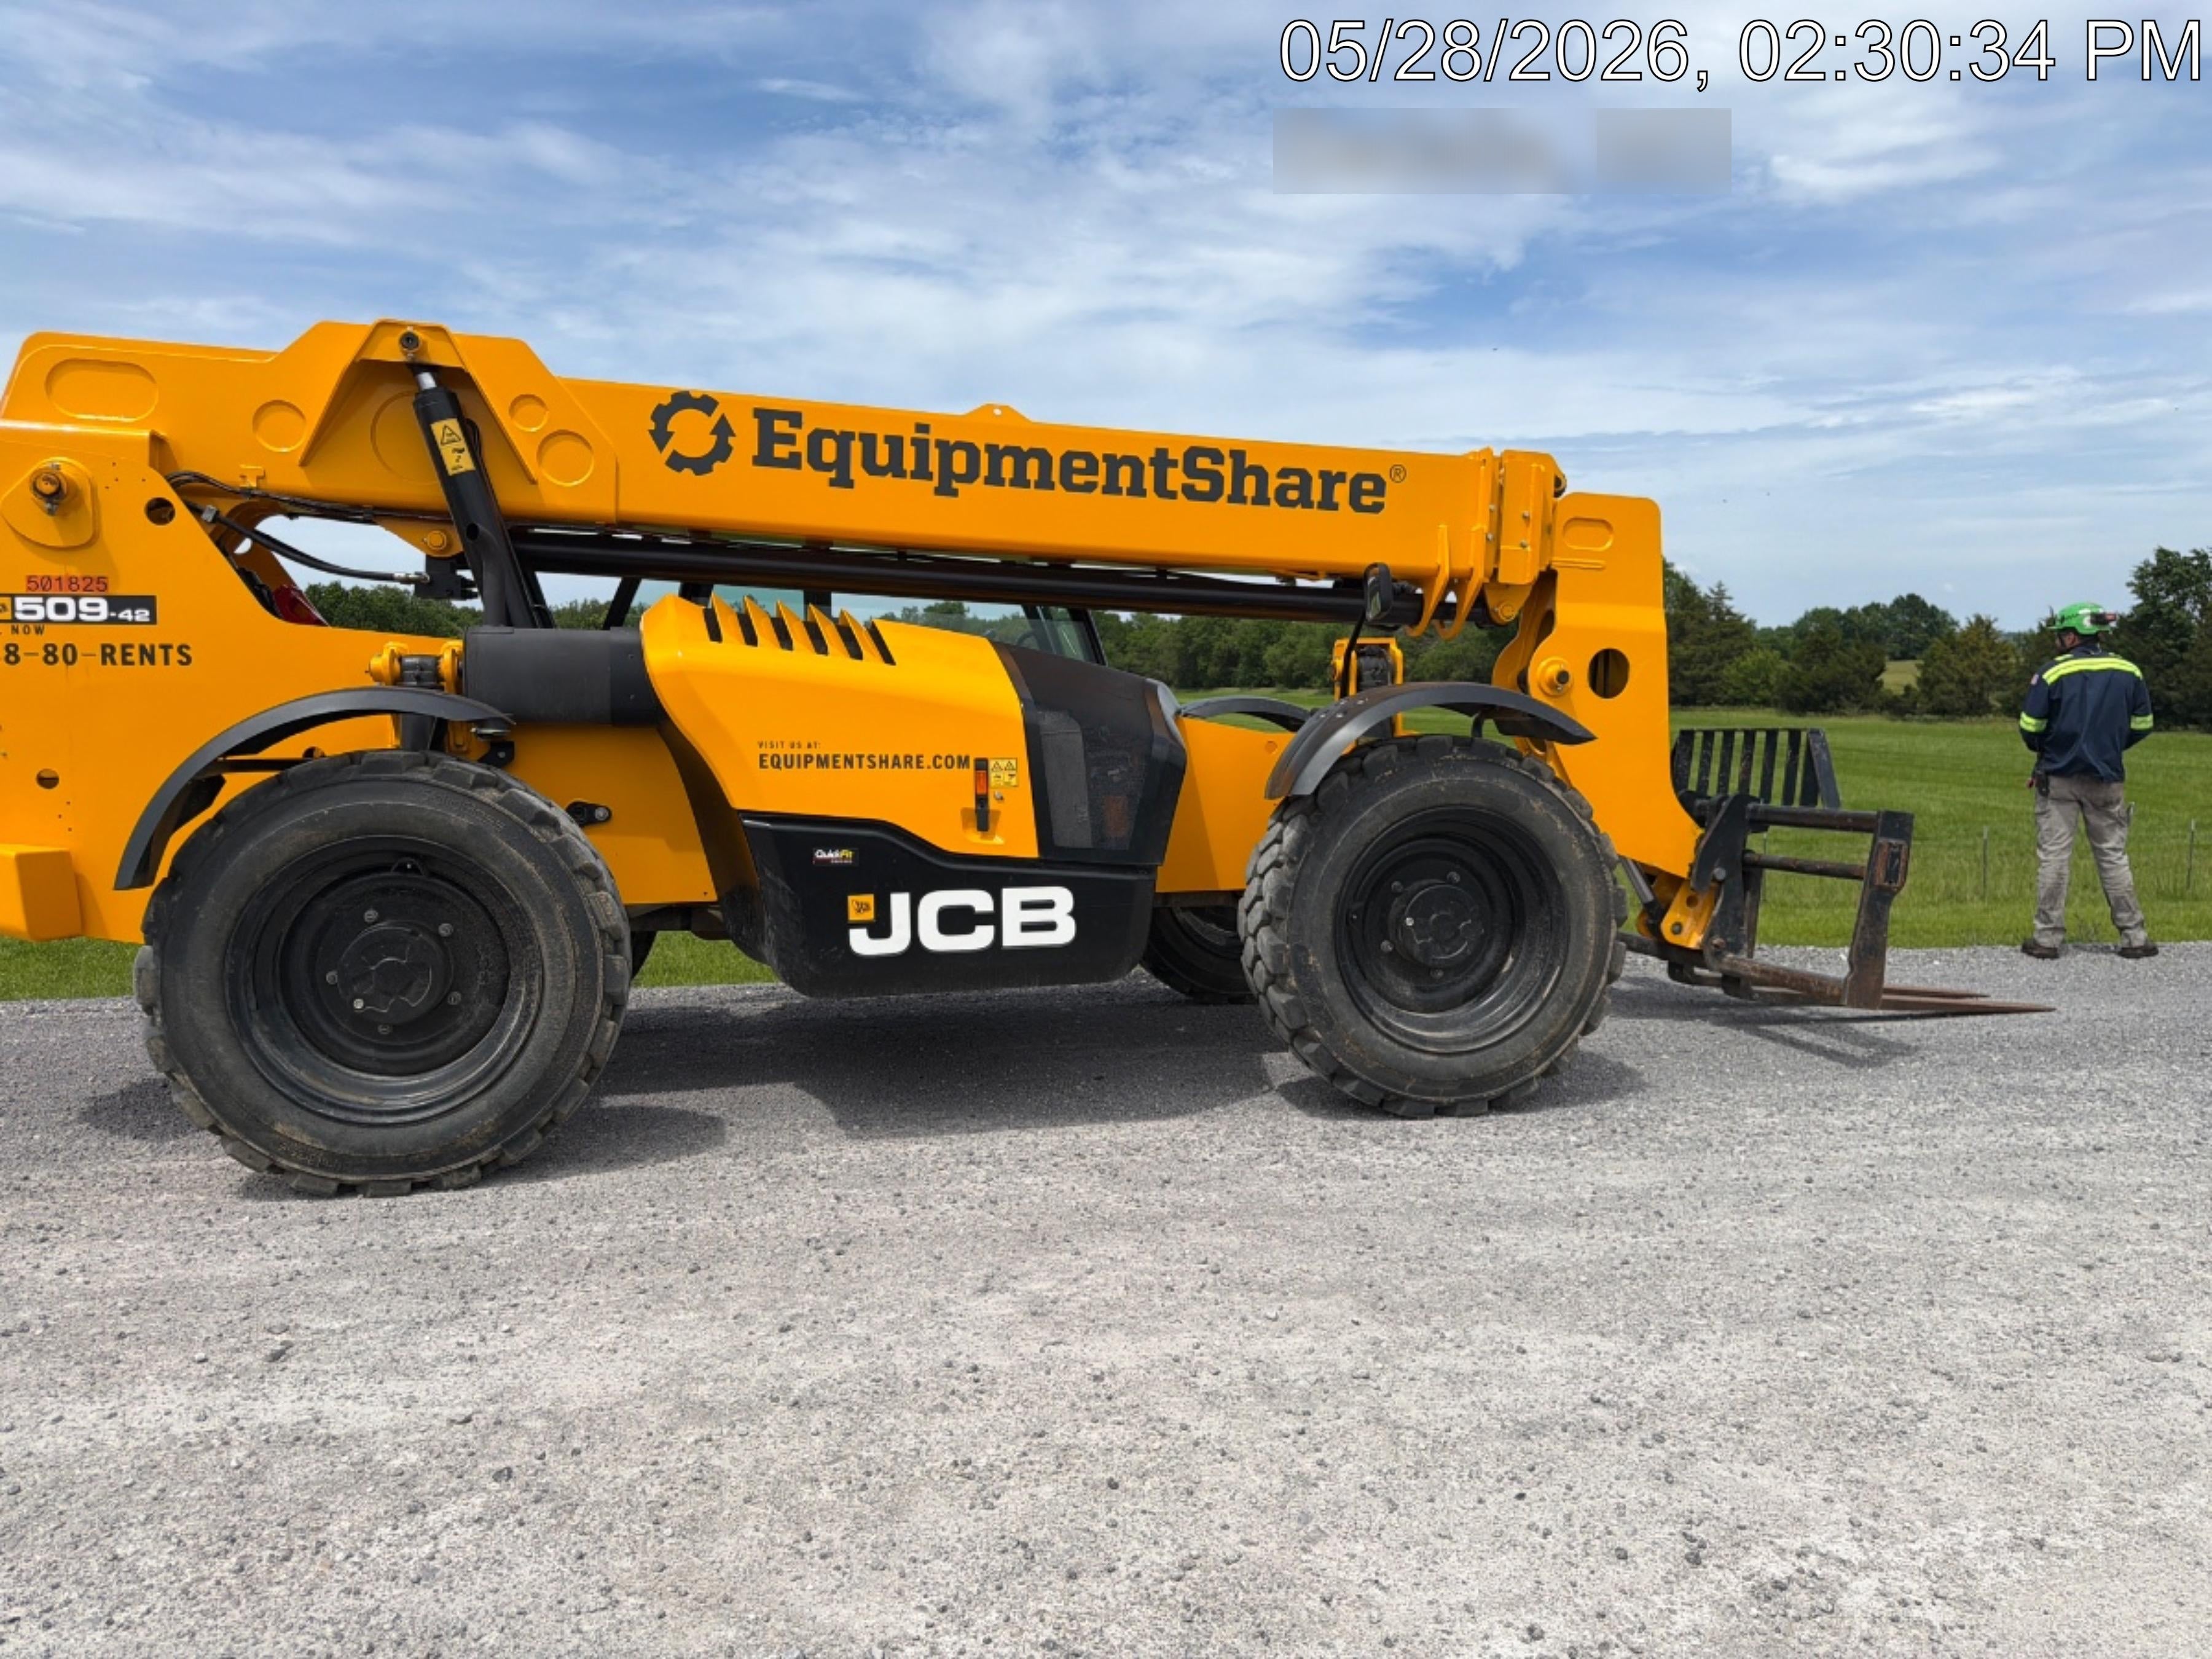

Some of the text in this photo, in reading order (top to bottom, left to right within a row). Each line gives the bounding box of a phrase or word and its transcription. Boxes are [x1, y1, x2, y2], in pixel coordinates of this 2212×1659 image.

[26, 575, 109, 592] 501825
[10, 624, 45, 635] NOW
[0, 643, 192, 666] 8-80-RENTS
[758, 740, 785, 749] VISIT
[758, 753, 970, 771] EQUIPMENTSHARE.COM
[849, 885, 1077, 956] JCB
